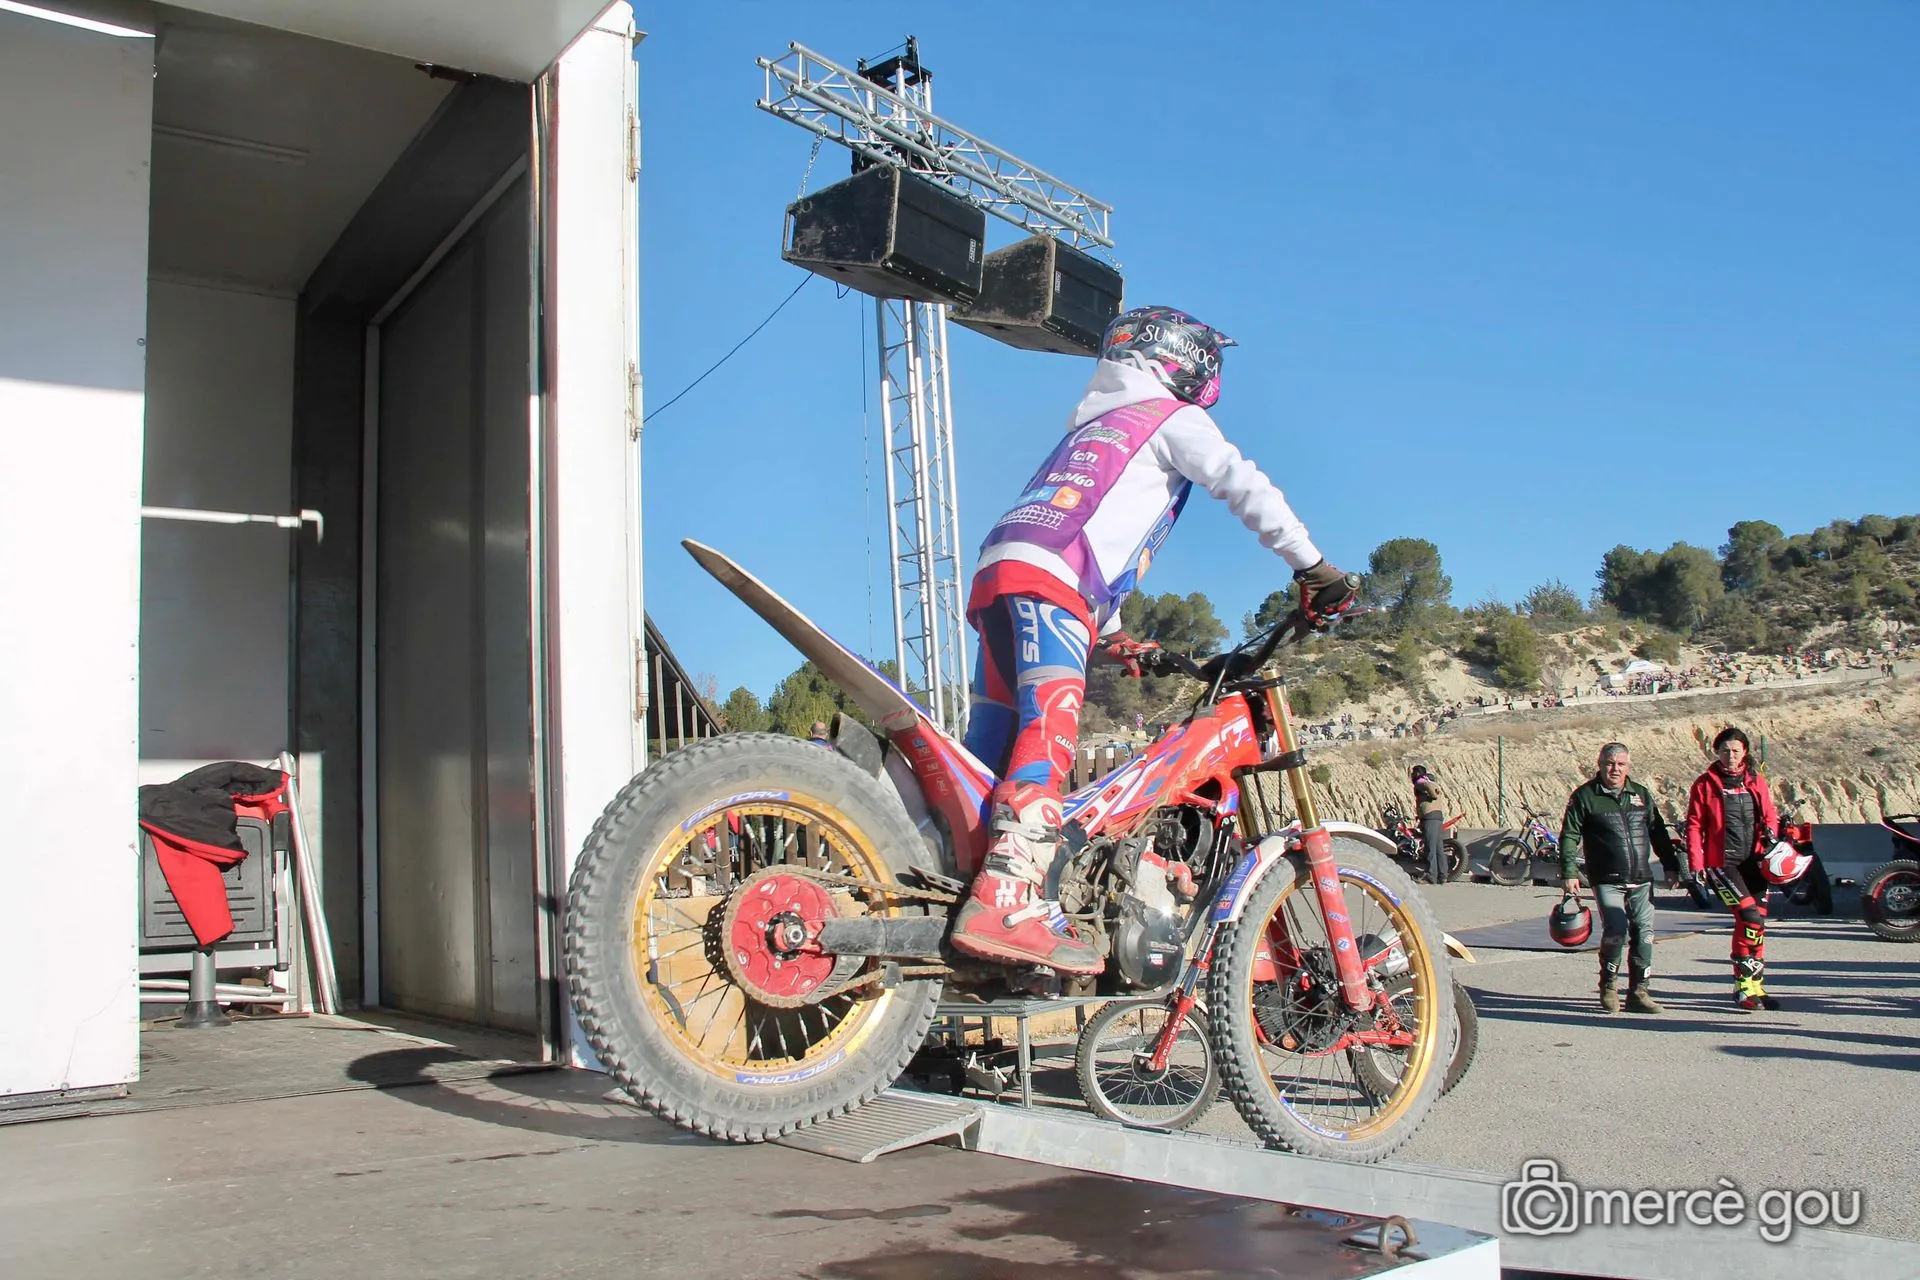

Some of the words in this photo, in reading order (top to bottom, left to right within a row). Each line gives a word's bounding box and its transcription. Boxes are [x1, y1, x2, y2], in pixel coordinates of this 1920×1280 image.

[1141, 324, 1219, 377] SUMARROCA
[1069, 450, 1098, 463] fcm
[1014, 596, 1041, 664] OTS
[686, 790, 784, 828] FACTORY
[1338, 868, 1398, 901] FACTORY
[743, 1052, 841, 1085] FACTORY
